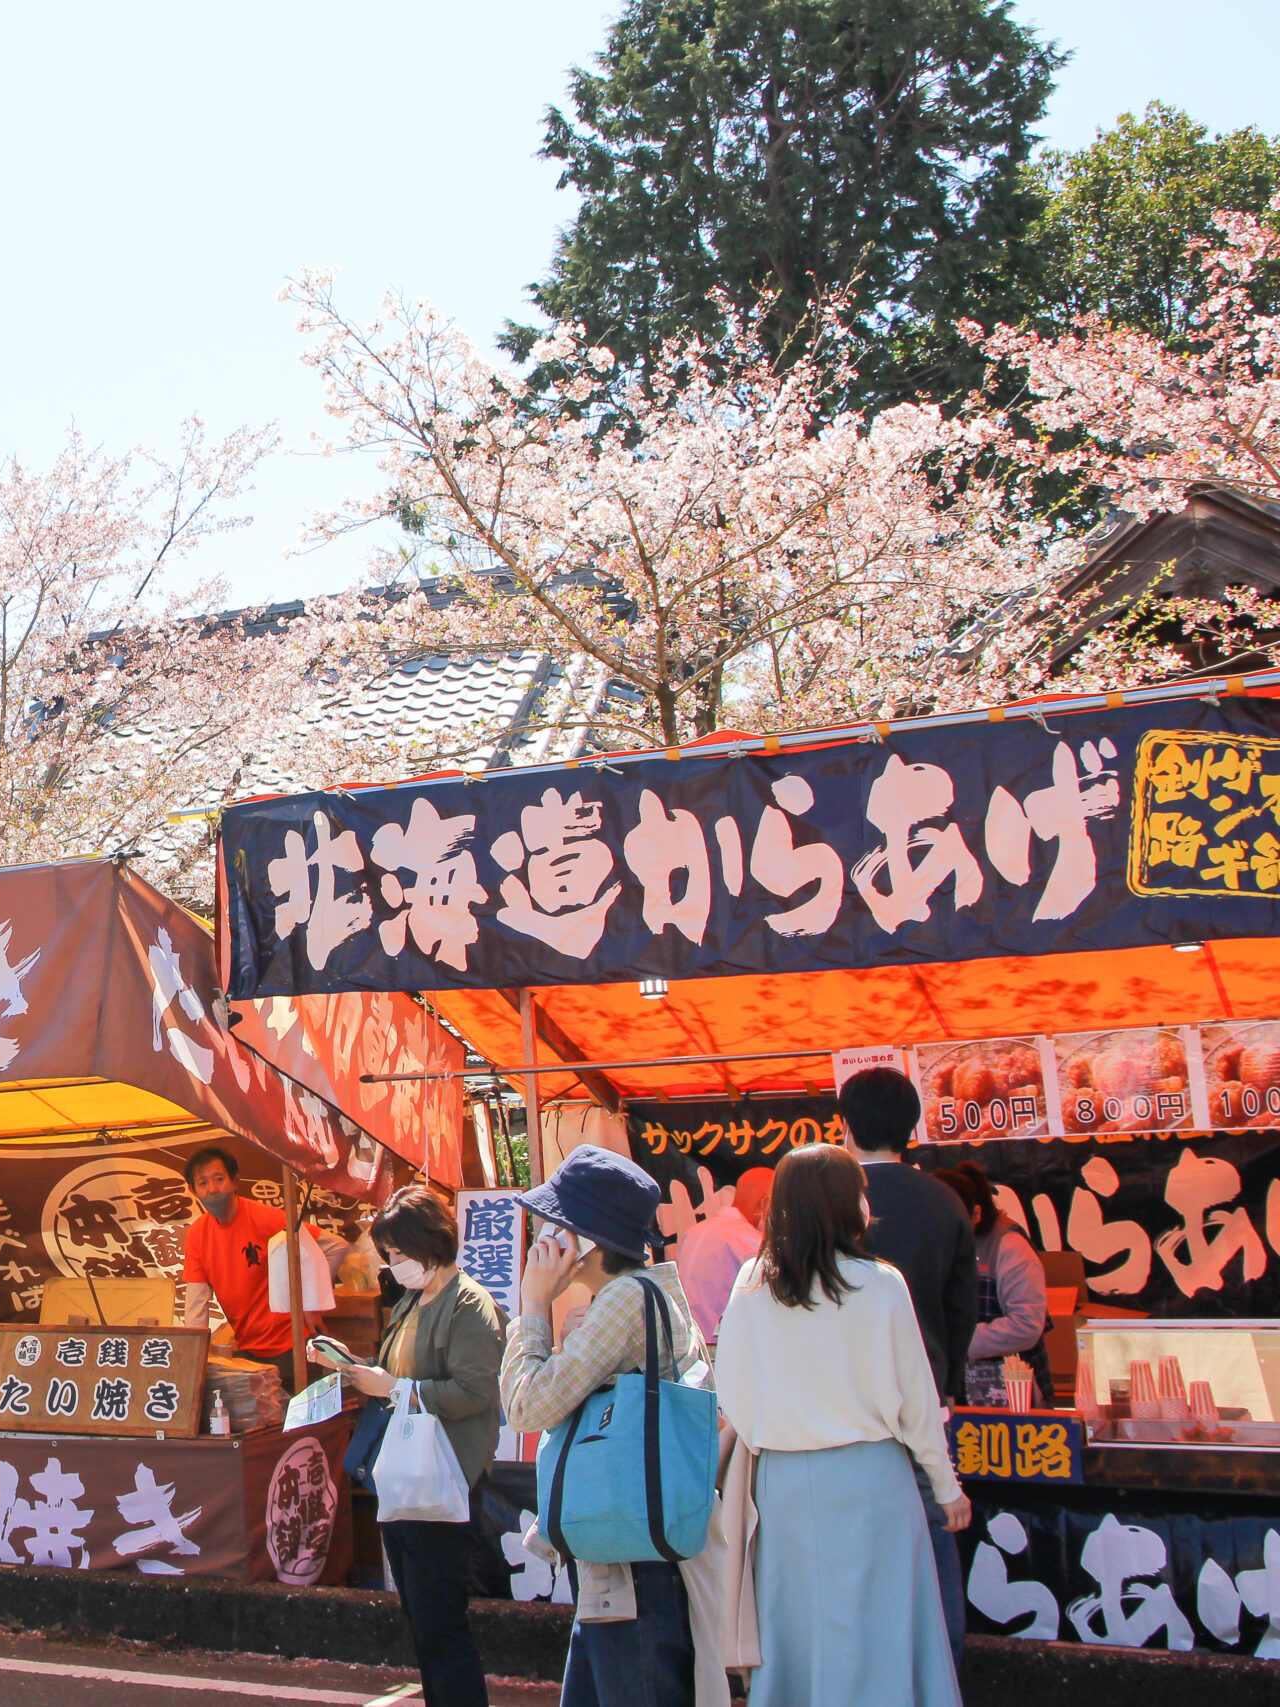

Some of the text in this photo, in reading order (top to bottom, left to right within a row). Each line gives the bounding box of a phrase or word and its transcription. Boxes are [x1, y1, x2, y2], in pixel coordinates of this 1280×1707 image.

[268, 737, 1120, 971] 北海道からあげ
[939, 1095, 1038, 1133] 500円
[1076, 1092, 1186, 1125] 800円
[463, 1198, 516, 1313] 厳選
[56, 1337, 173, 1367] 壱銭堂
[956, 1421, 1073, 1479] 釧路
